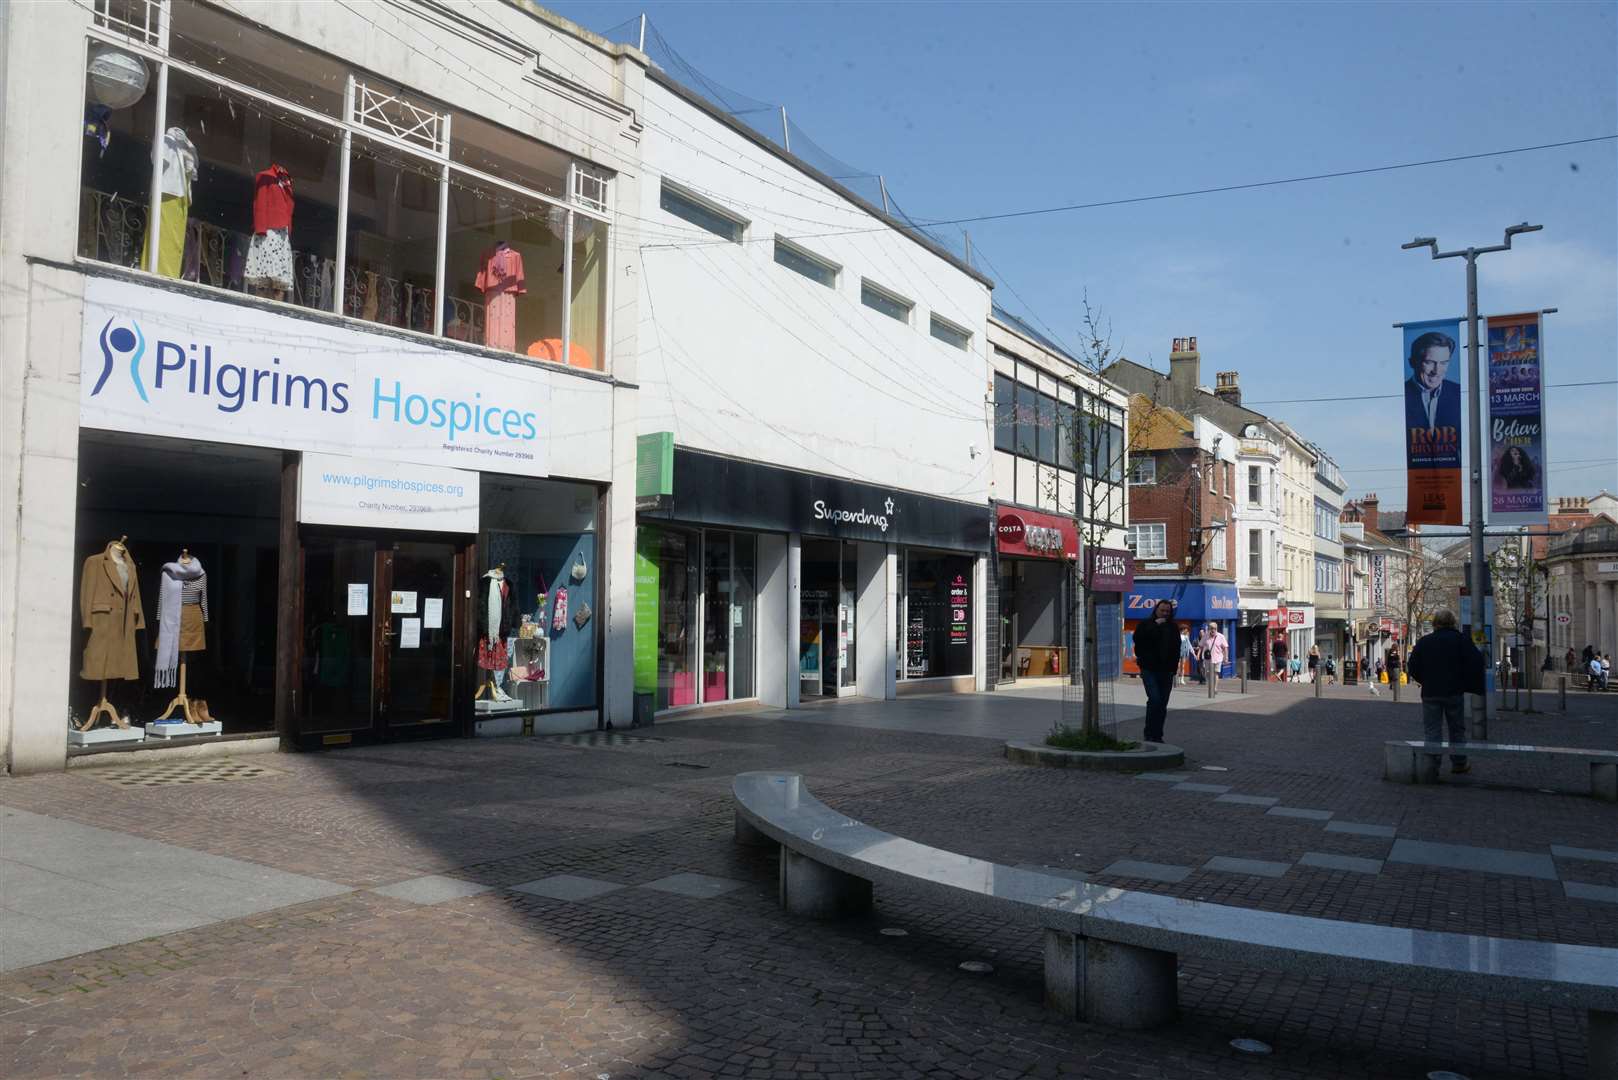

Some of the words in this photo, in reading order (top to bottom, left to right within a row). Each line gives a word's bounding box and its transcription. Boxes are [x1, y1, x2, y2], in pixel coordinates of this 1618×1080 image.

[153, 339, 350, 414] Pilgrims
[371, 377, 537, 441] Hospices
[1491, 395, 1501, 404] 13
[1503, 392, 1540, 403] MARCH
[1410, 426, 1456, 442] ROB
[1493, 418, 1540, 442] Believe
[474, 446, 493, 456] Charity
[494, 448, 514, 458] Number
[322, 471, 464, 498] www.pilgrimshospices.org
[358, 500, 381, 512] Charity
[1506, 494, 1543, 505] MARCH
[814, 500, 889, 532] Superdrug
[998, 525, 1022, 533] COSTA
